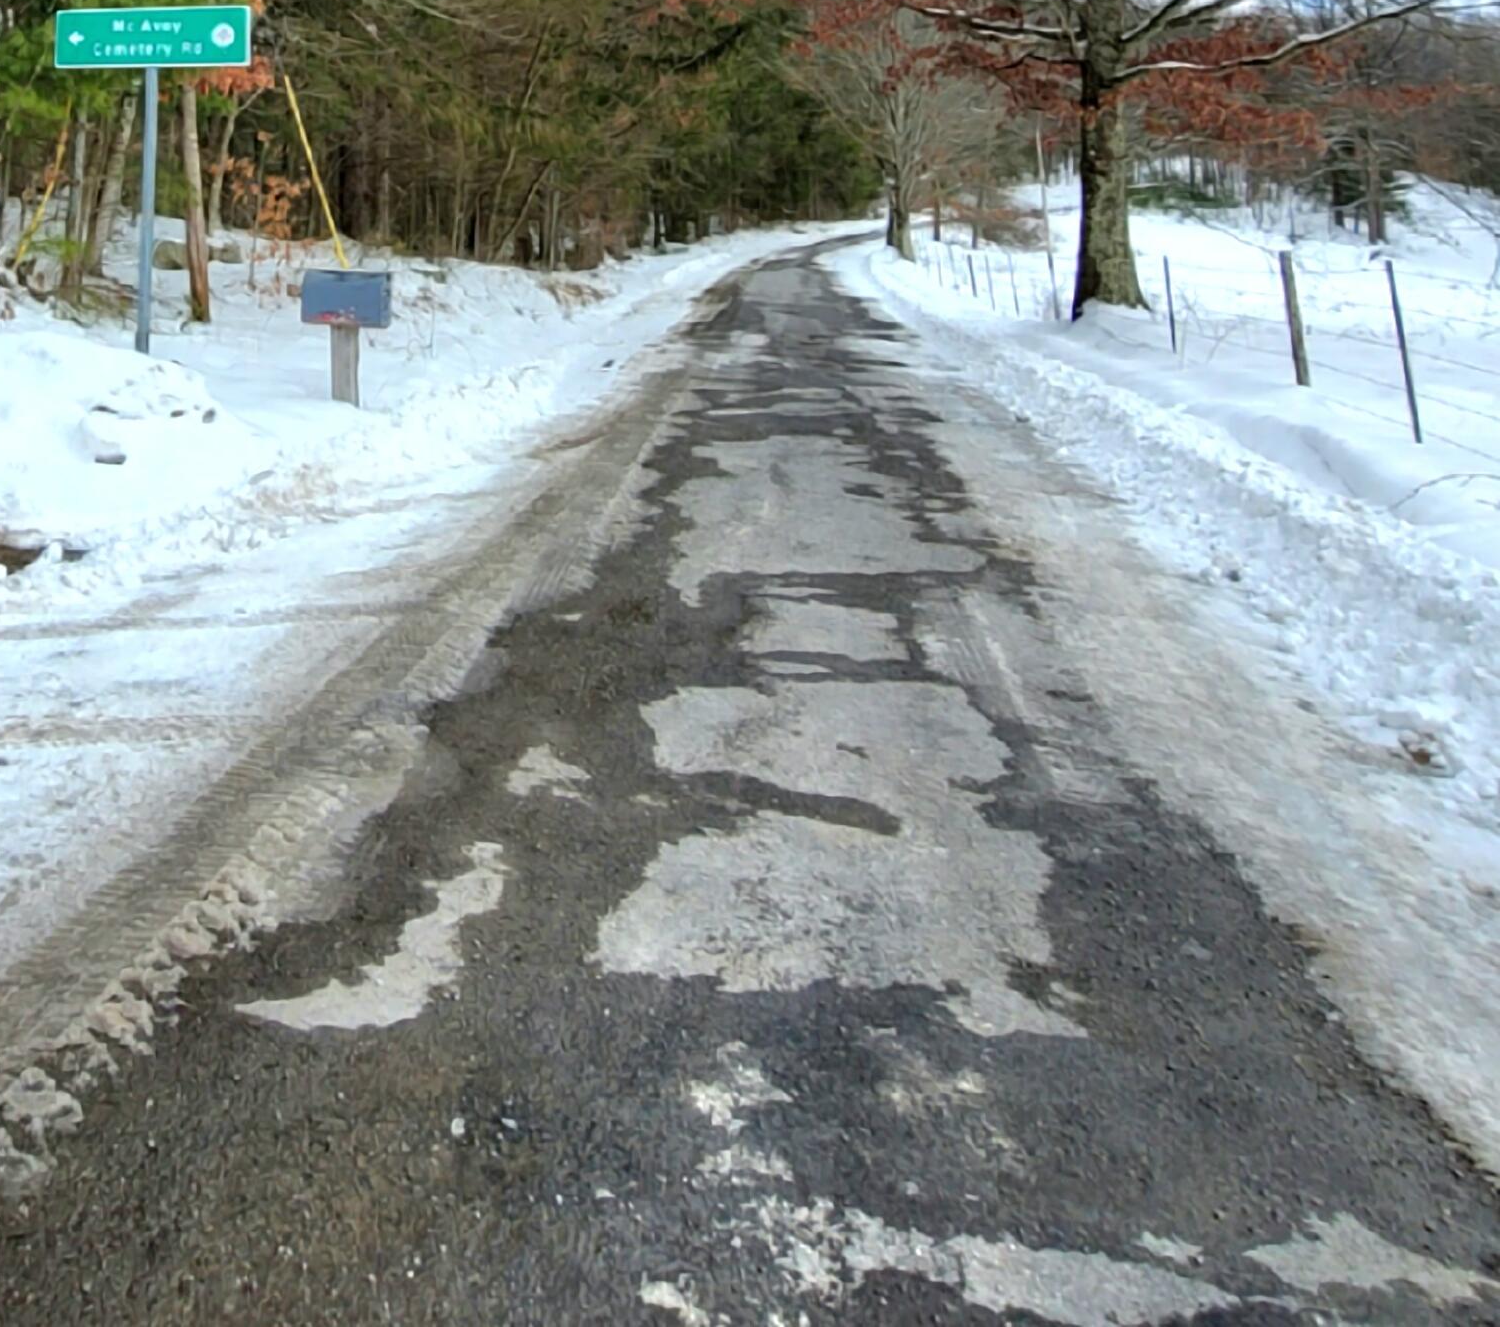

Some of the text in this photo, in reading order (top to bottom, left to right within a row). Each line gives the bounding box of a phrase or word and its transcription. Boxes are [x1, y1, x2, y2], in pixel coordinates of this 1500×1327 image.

[112, 20, 134, 33] Mc
[93, 41, 203, 57] Cemetery Rd
